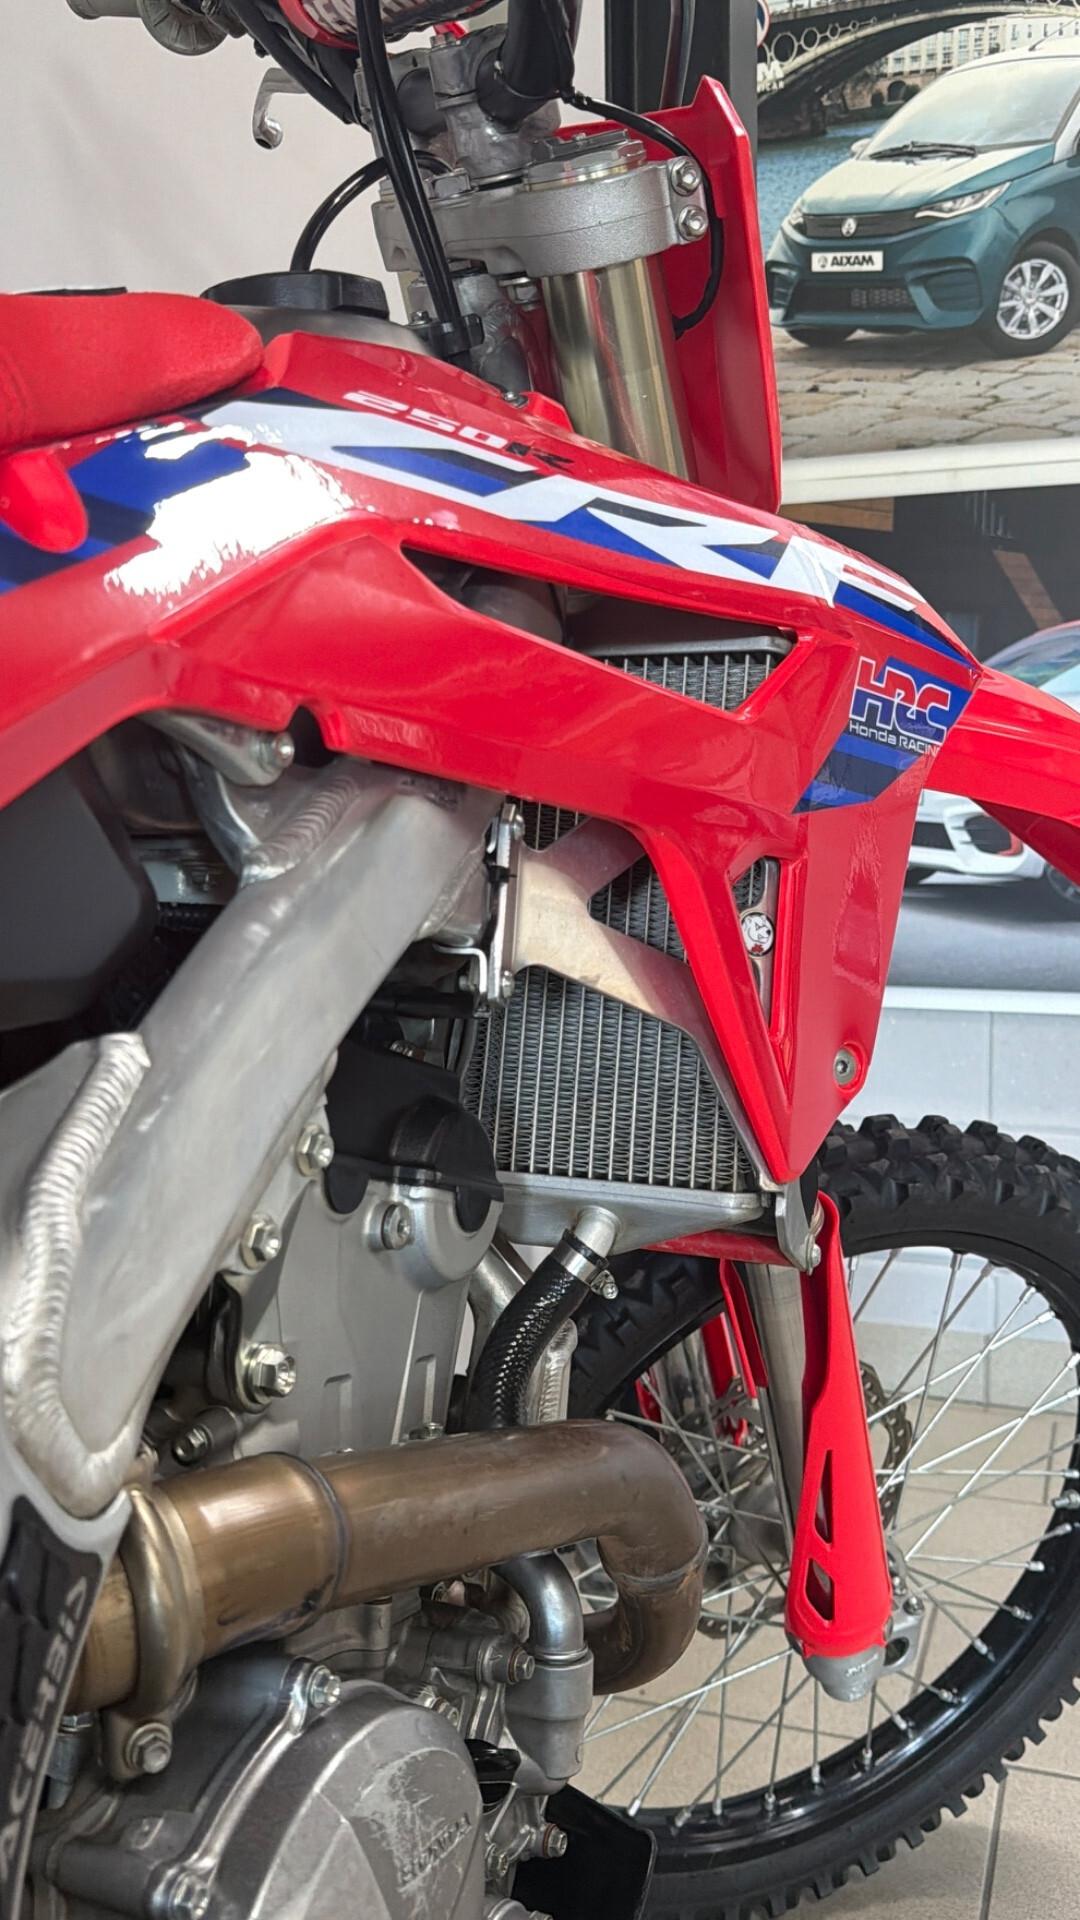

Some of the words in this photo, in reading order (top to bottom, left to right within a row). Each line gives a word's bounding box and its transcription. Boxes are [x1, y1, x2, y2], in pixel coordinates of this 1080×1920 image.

[831, 254, 875, 267] AIXAM
[849, 655, 951, 746] HRC
[849, 720, 897, 745] Honda
[899, 735, 942, 757] RACIN
